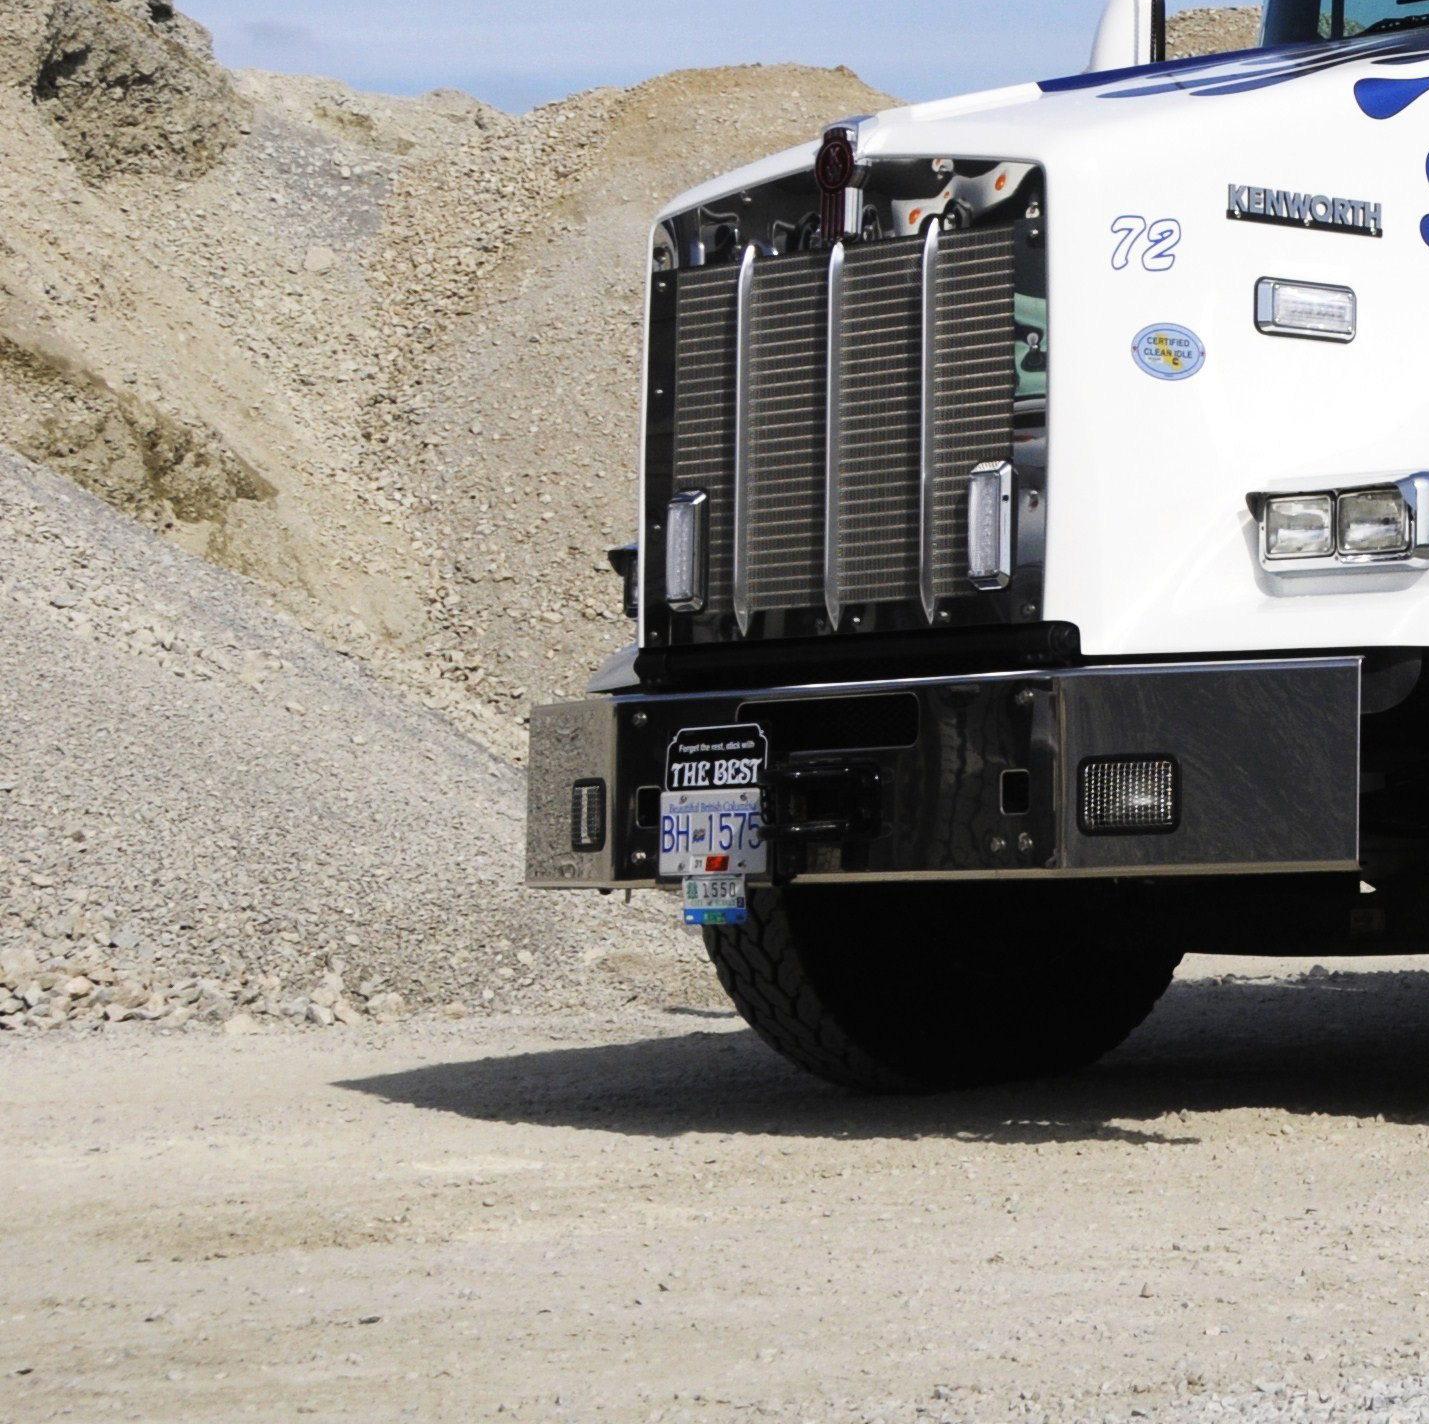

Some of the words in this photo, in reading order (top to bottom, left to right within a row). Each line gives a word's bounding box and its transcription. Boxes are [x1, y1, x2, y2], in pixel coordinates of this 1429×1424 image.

[1227, 183, 1382, 230] KENWORTH
[1110, 214, 1182, 272] 72
[1146, 336, 1190, 347] CERTIFIED
[1143, 347, 1172, 357] CLEAN
[1174, 349, 1193, 359] IDLE
[678, 744, 700, 754] Forget
[671, 762, 711, 787] THE
[713, 757, 763, 785] BEST
[669, 803, 699, 813] Beautiful
[700, 801, 721, 812] British
[723, 800, 758, 811] Columbia
[702, 881, 736, 898] 1550
